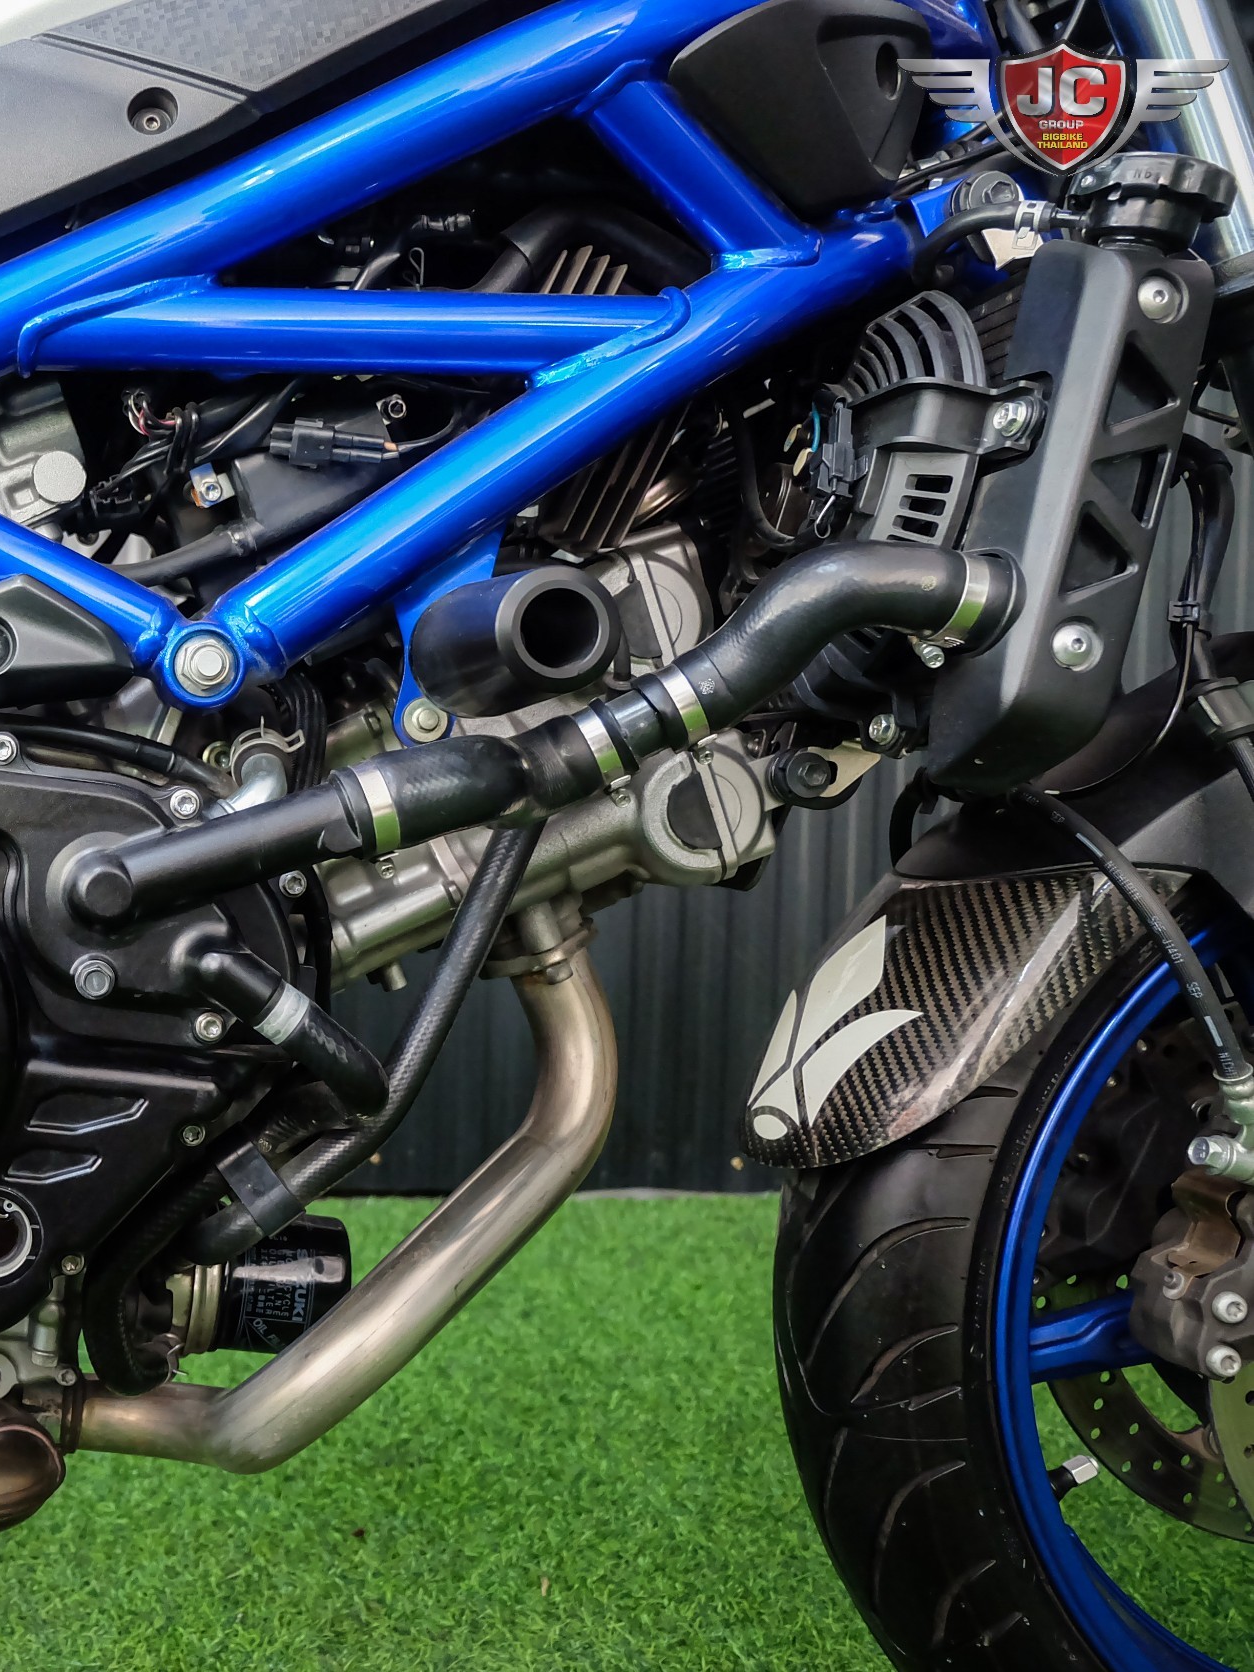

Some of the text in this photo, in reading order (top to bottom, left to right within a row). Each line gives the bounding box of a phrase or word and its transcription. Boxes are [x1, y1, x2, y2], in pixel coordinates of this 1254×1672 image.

[1162, 939, 1185, 965] J1401
[1186, 981, 1204, 998] SEP
[252, 1318, 268, 1334] OIL
